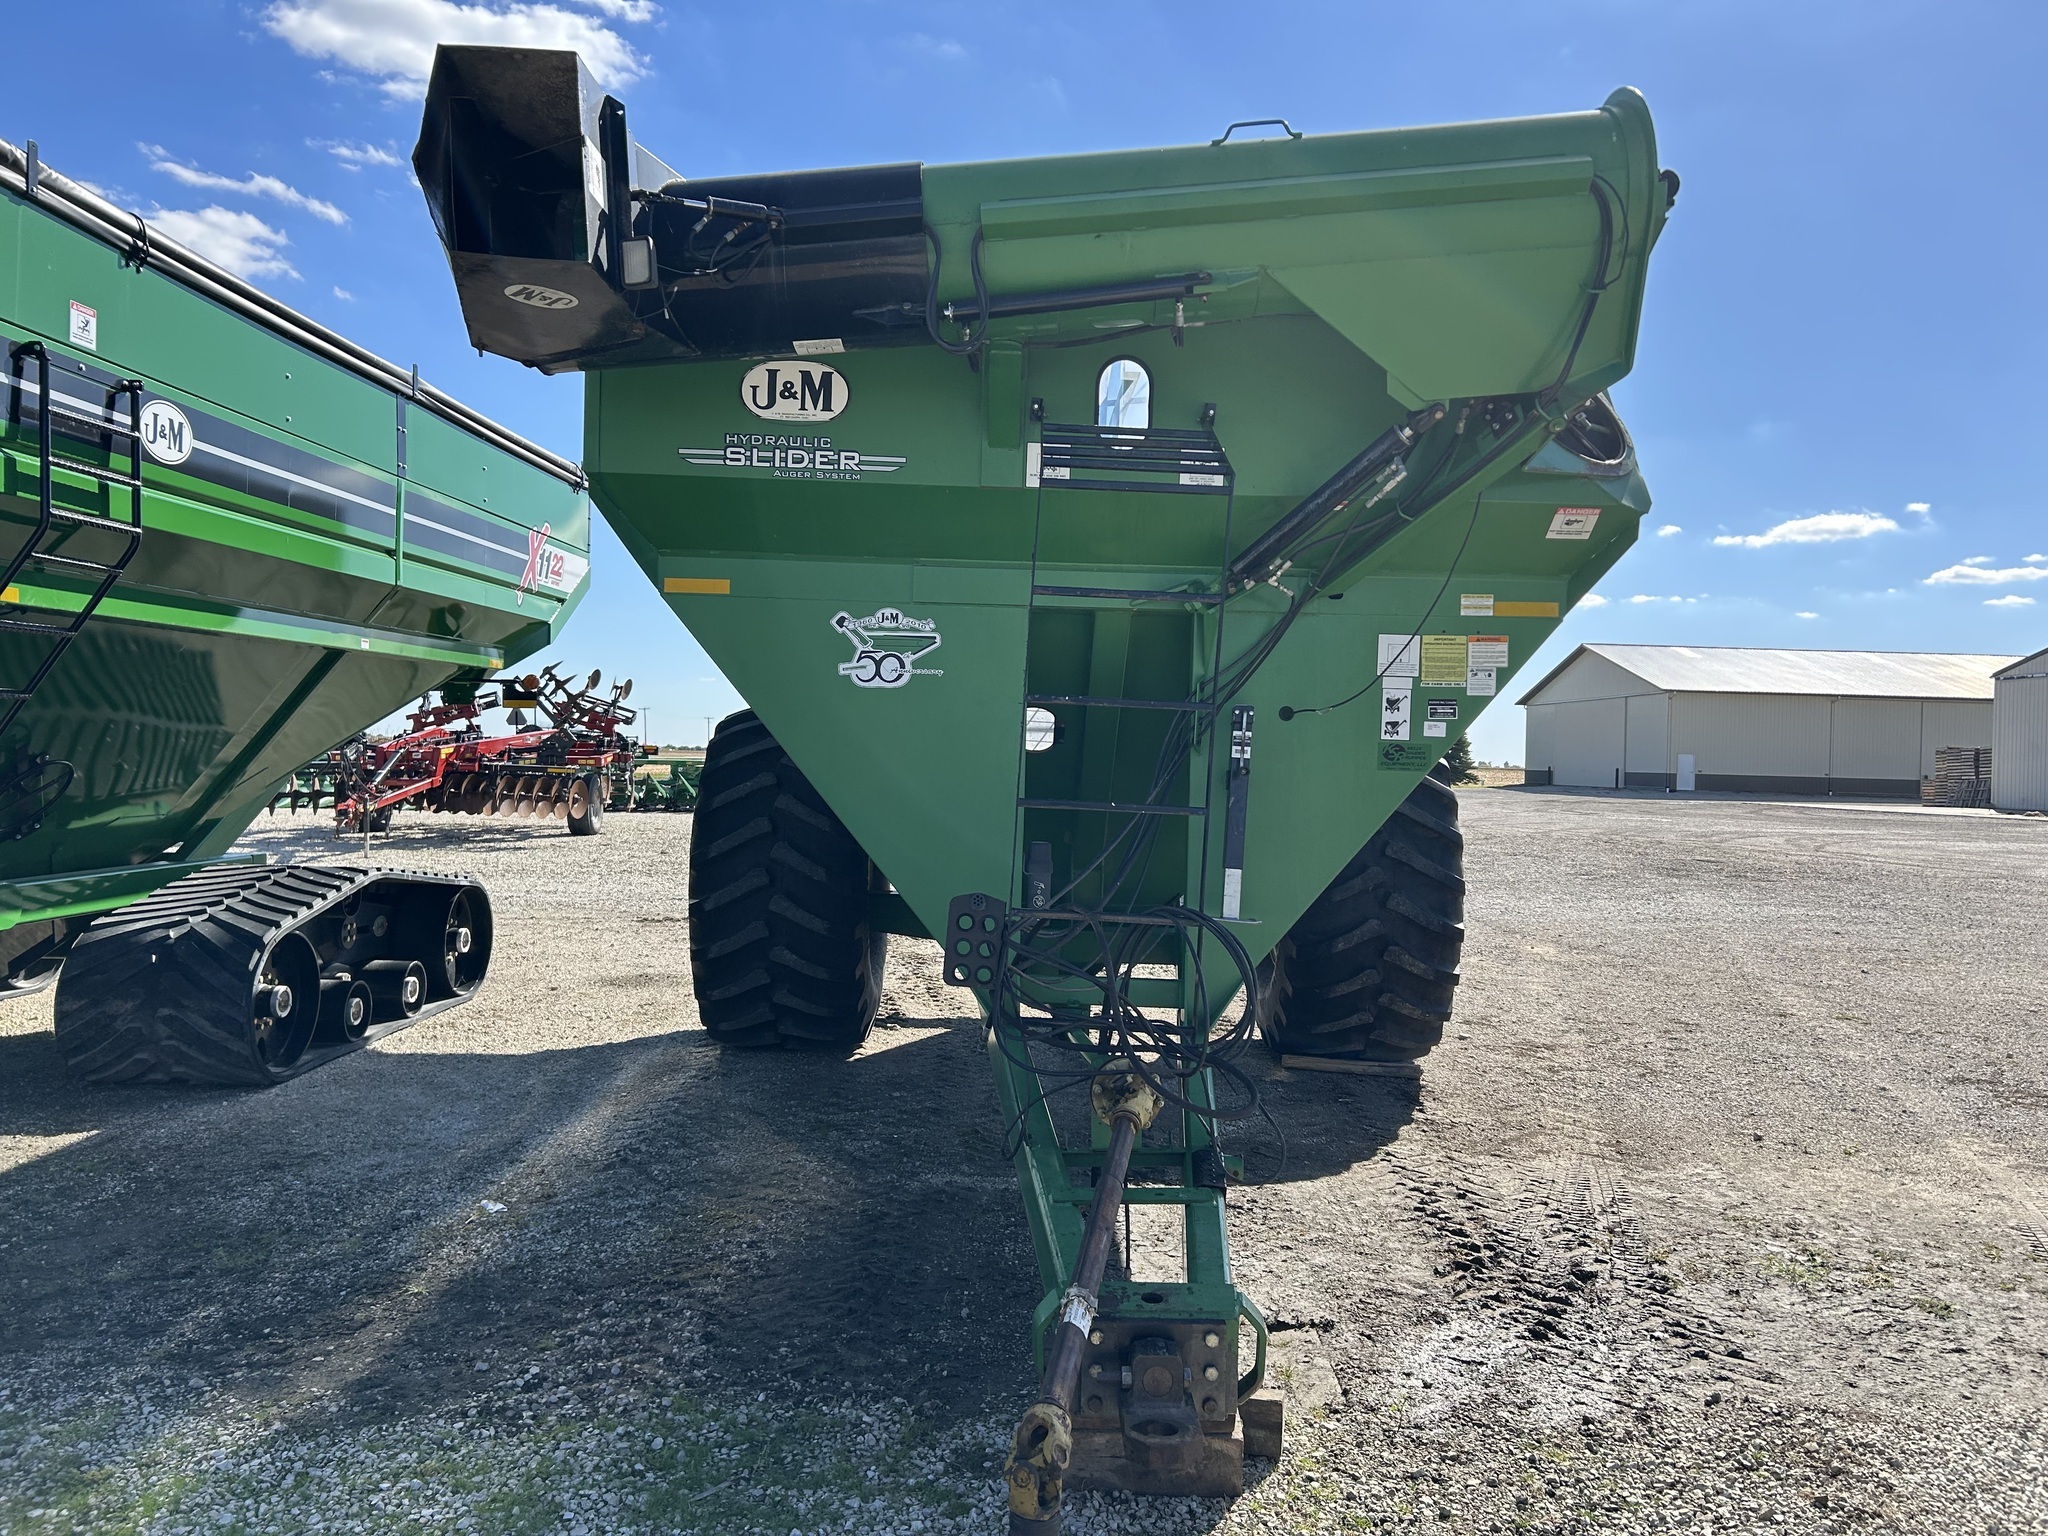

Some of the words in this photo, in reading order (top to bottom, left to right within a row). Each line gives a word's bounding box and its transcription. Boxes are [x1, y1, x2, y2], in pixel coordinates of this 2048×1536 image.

[508, 285, 574, 307] J&M
[749, 368, 835, 412] J&M
[143, 411, 184, 454] J&M
[725, 433, 832, 448] HYDRAULIC
[723, 446, 862, 472] SLIDER
[773, 469, 811, 480] AUGER
[816, 471, 861, 481] SYSTEM
[877, 611, 900, 625] J&M
[905, 619, 927, 630] 2010
